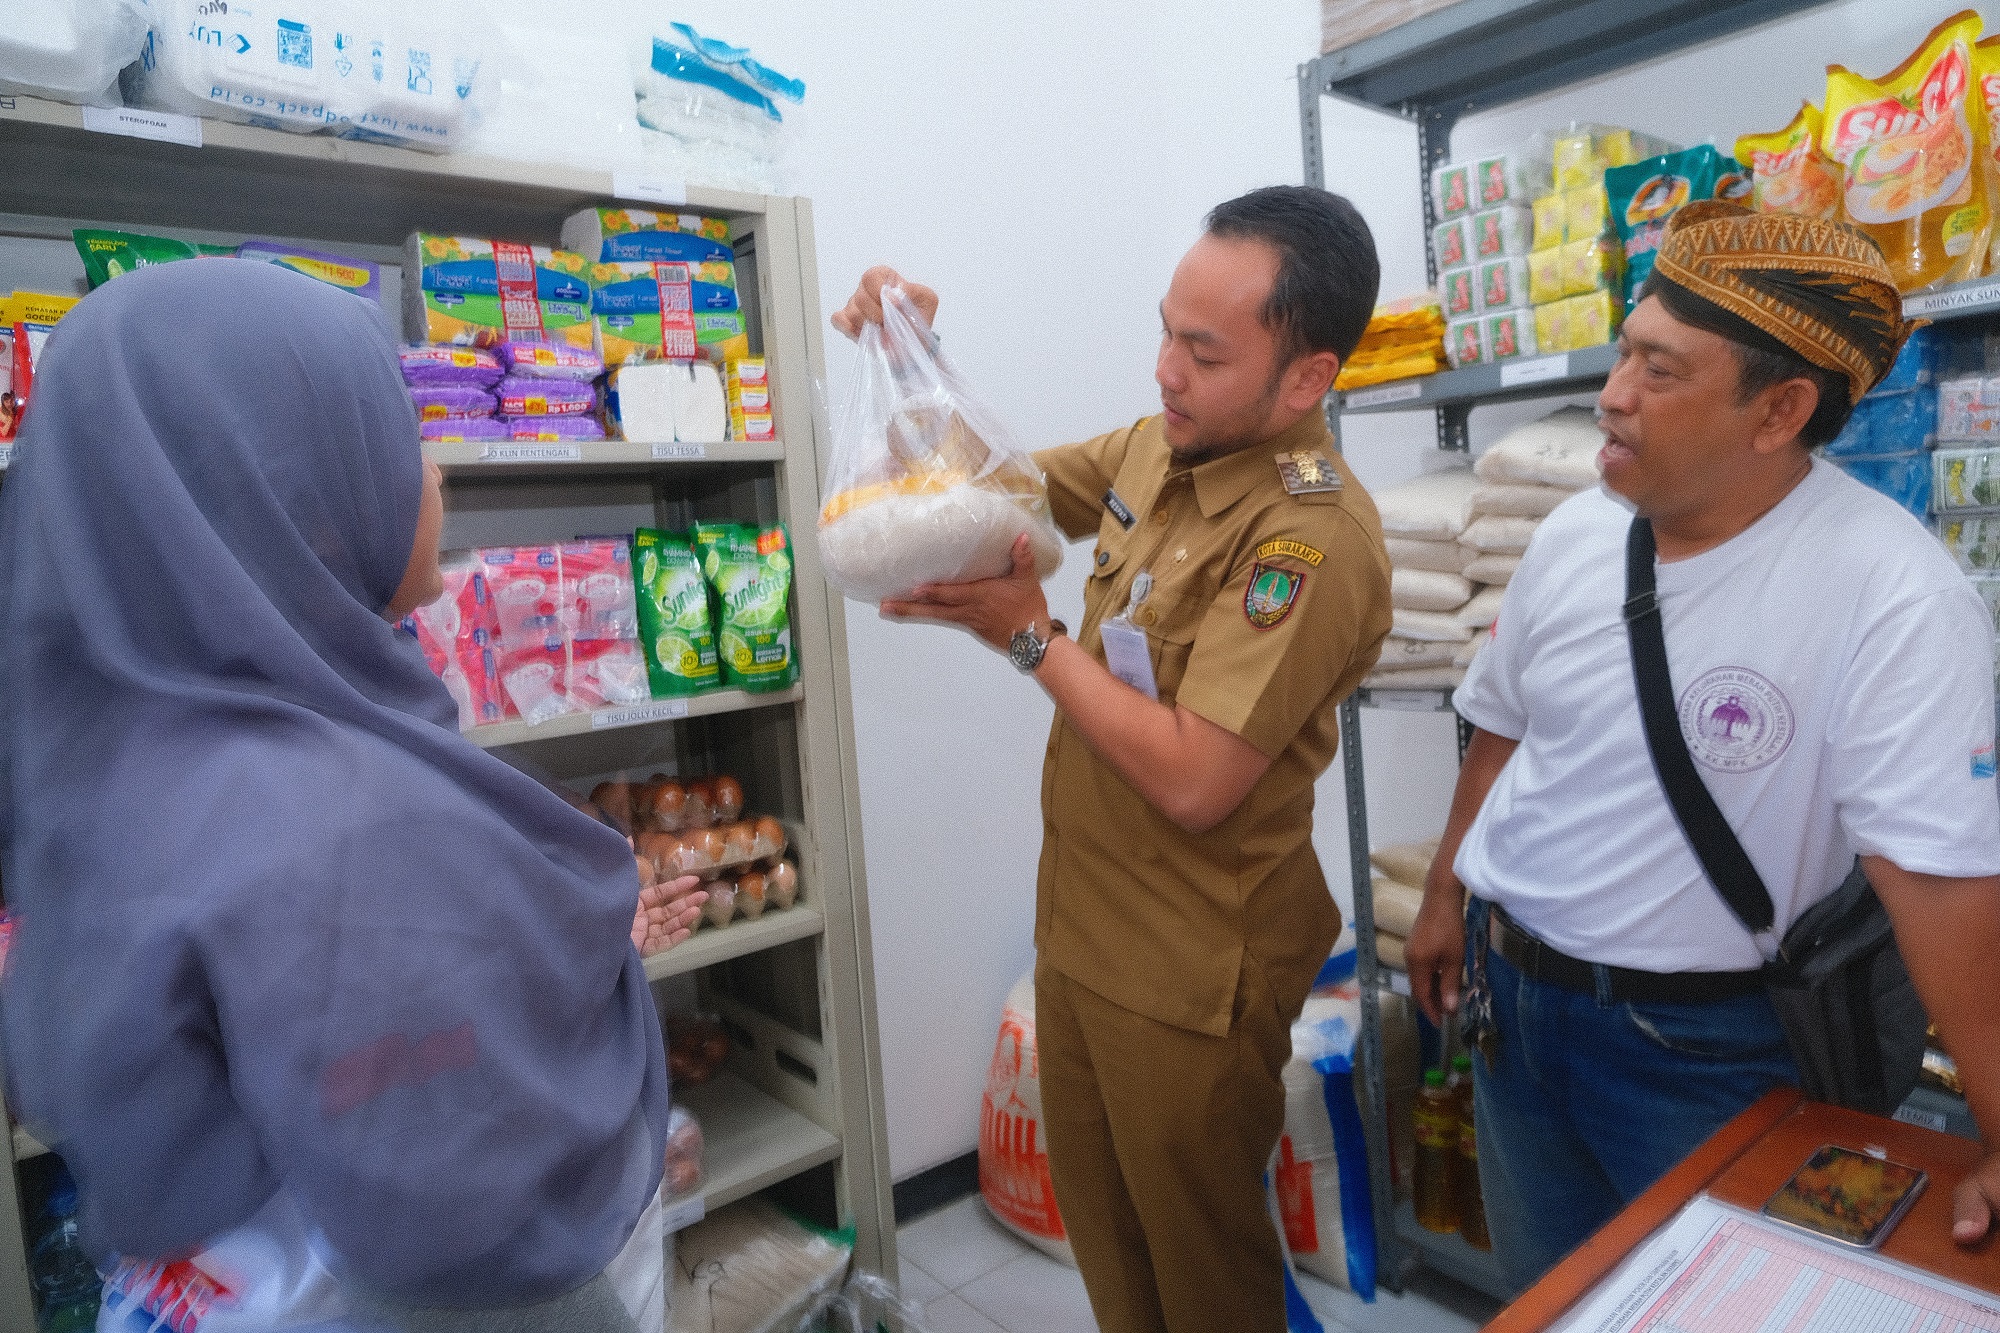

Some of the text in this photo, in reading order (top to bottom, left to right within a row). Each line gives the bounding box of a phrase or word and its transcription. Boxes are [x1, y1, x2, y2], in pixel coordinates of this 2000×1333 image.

[210, 85, 449, 137] www.luxfodpack.co.id
[119, 115, 167, 128] STEROFOAM
[1924, 293, 1975, 310] MINYAK
[547, 404, 560, 414] Rp
[499, 450, 518, 458] KLIN
[519, 449, 570, 458] RENTENGAN
[656, 447, 700, 456] TISU TESSA
[1258, 541, 1321, 565] KOTA SURAKARTA
[661, 580, 707, 626] Sunlig
[723, 575, 786, 622] Sunlight
[607, 707, 674, 724] TISU JOLLY KECIL
